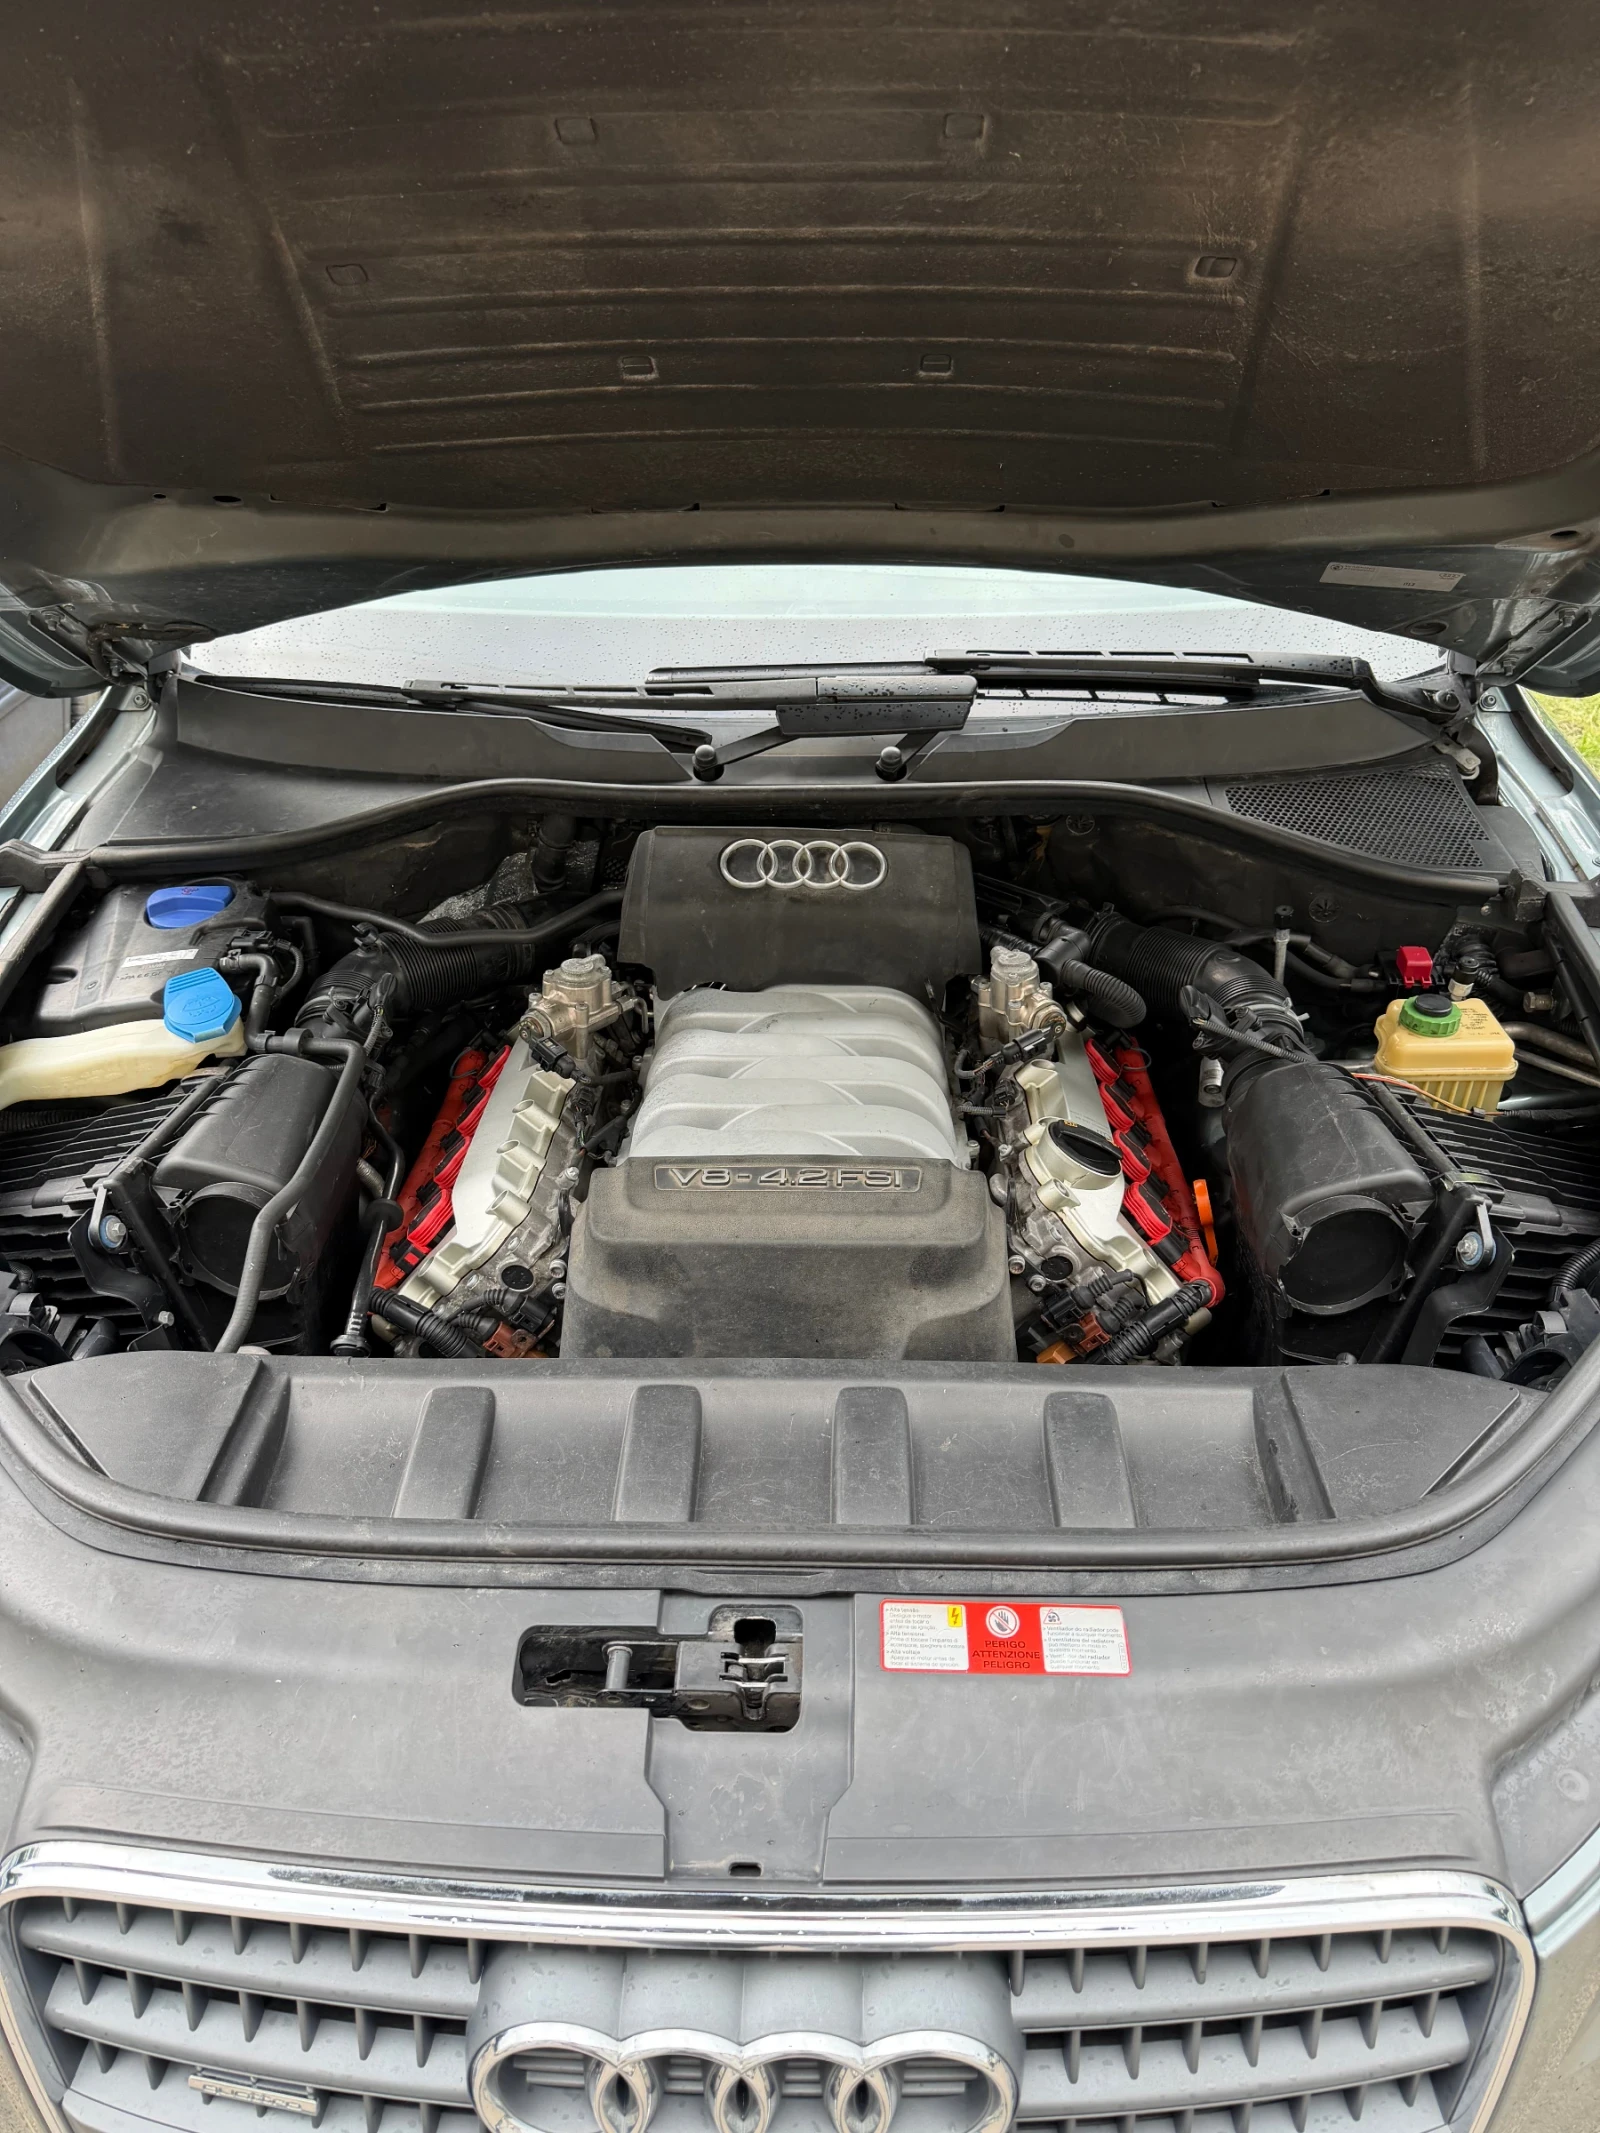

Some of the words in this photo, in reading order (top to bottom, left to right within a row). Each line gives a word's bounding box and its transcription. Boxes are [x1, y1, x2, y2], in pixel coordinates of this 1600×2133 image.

[669, 1167, 731, 1188] V8
[836, 1168, 902, 1189] FSI
[985, 1640, 1026, 1648] PERIGO
[972, 1650, 1040, 1659] ATTENZIONE
